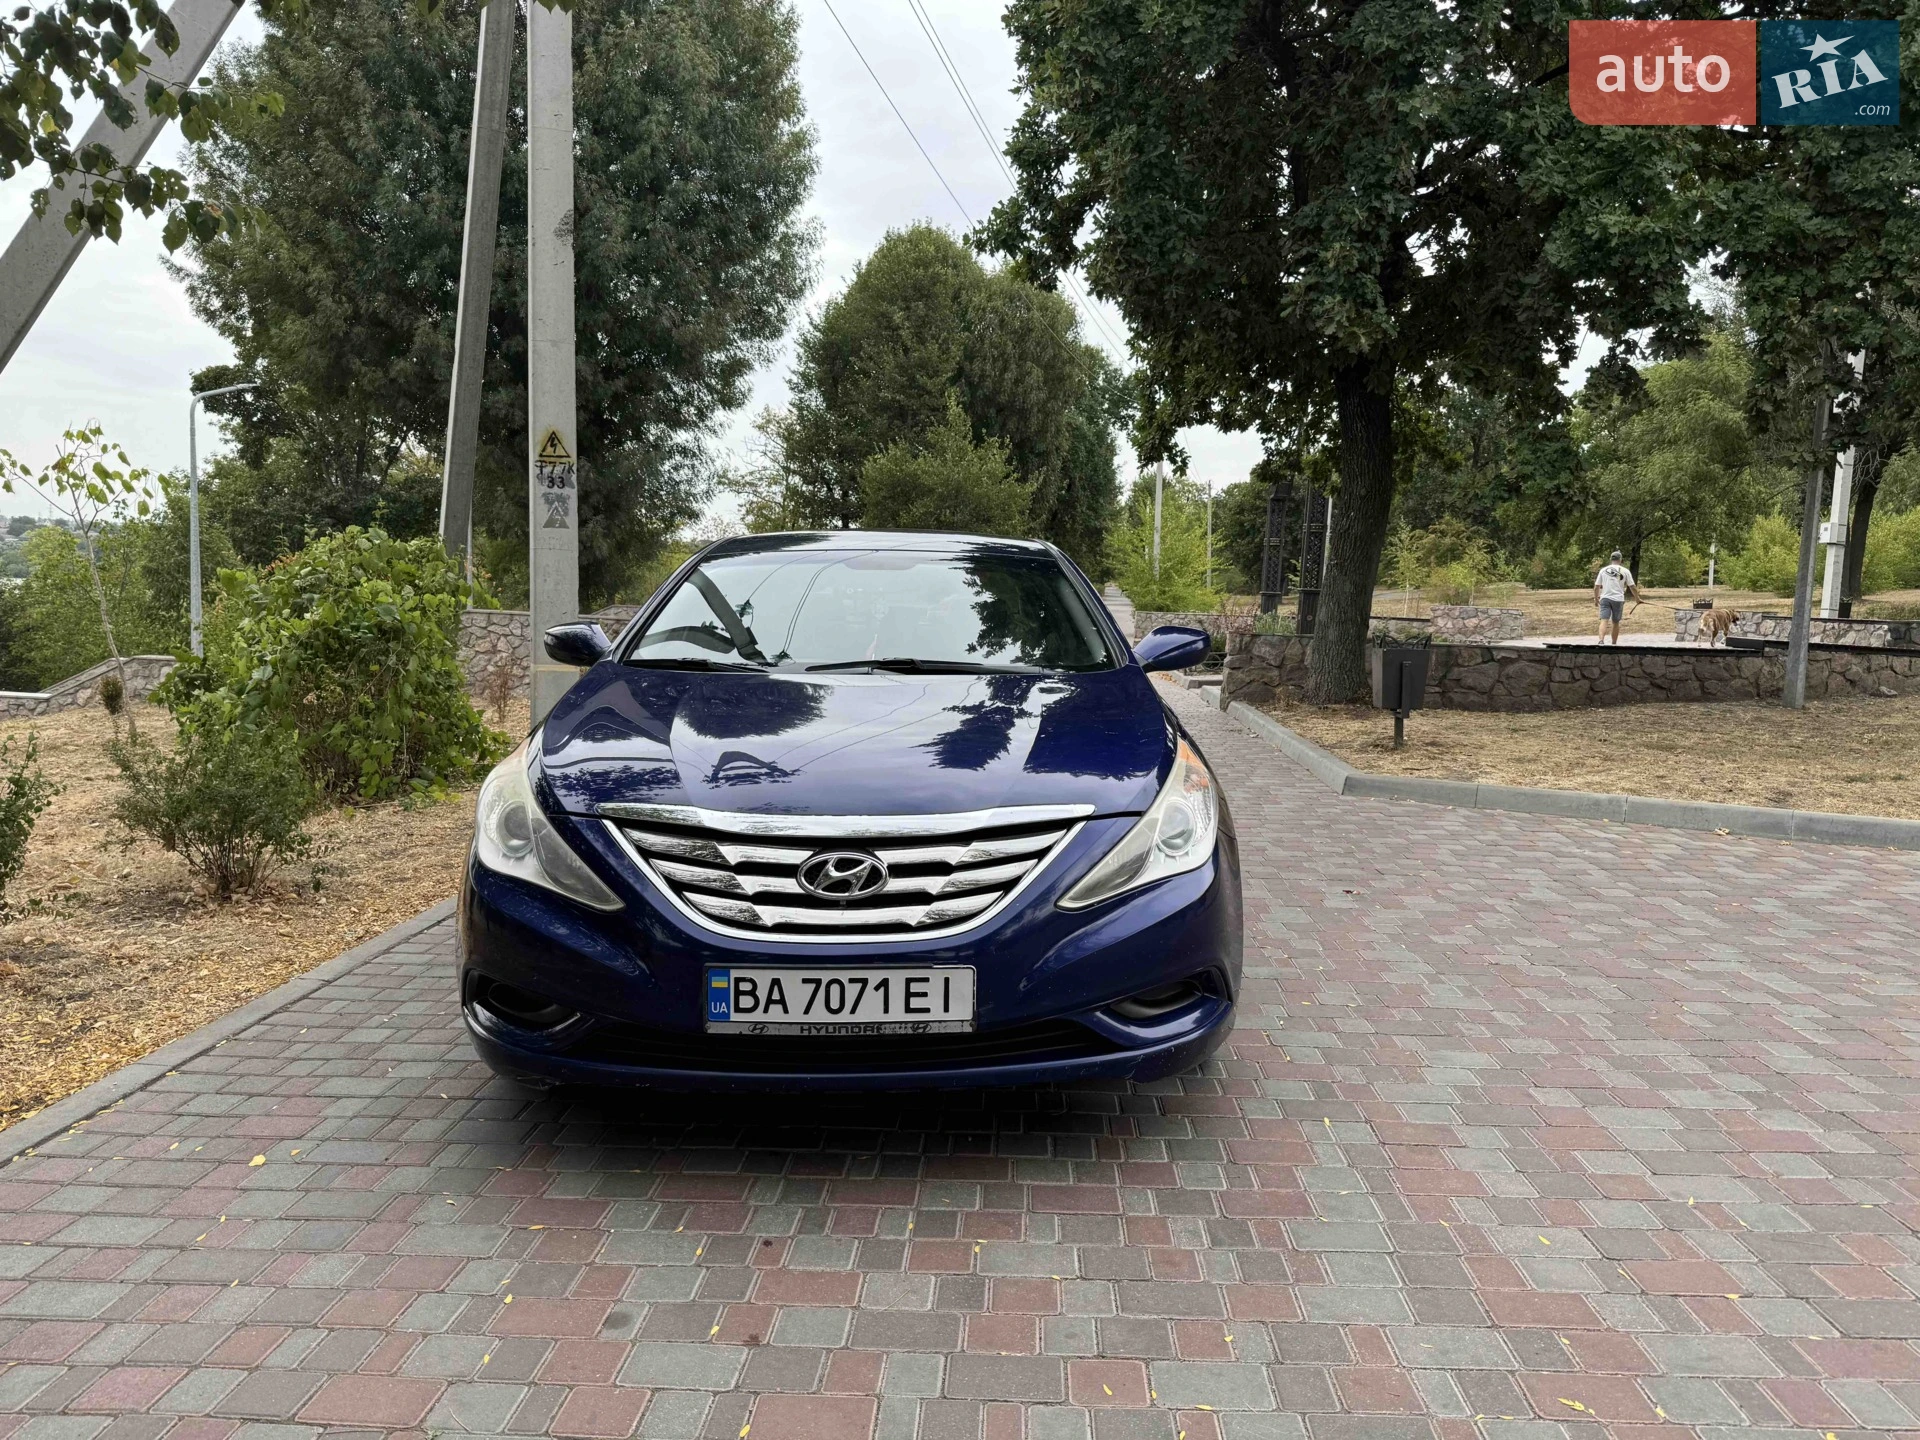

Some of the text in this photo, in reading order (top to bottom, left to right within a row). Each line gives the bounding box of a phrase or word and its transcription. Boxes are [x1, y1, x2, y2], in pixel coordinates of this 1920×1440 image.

[546, 475, 566, 489] 33
[801, 977, 890, 1015] 7071
[711, 1001, 728, 1013] UA
